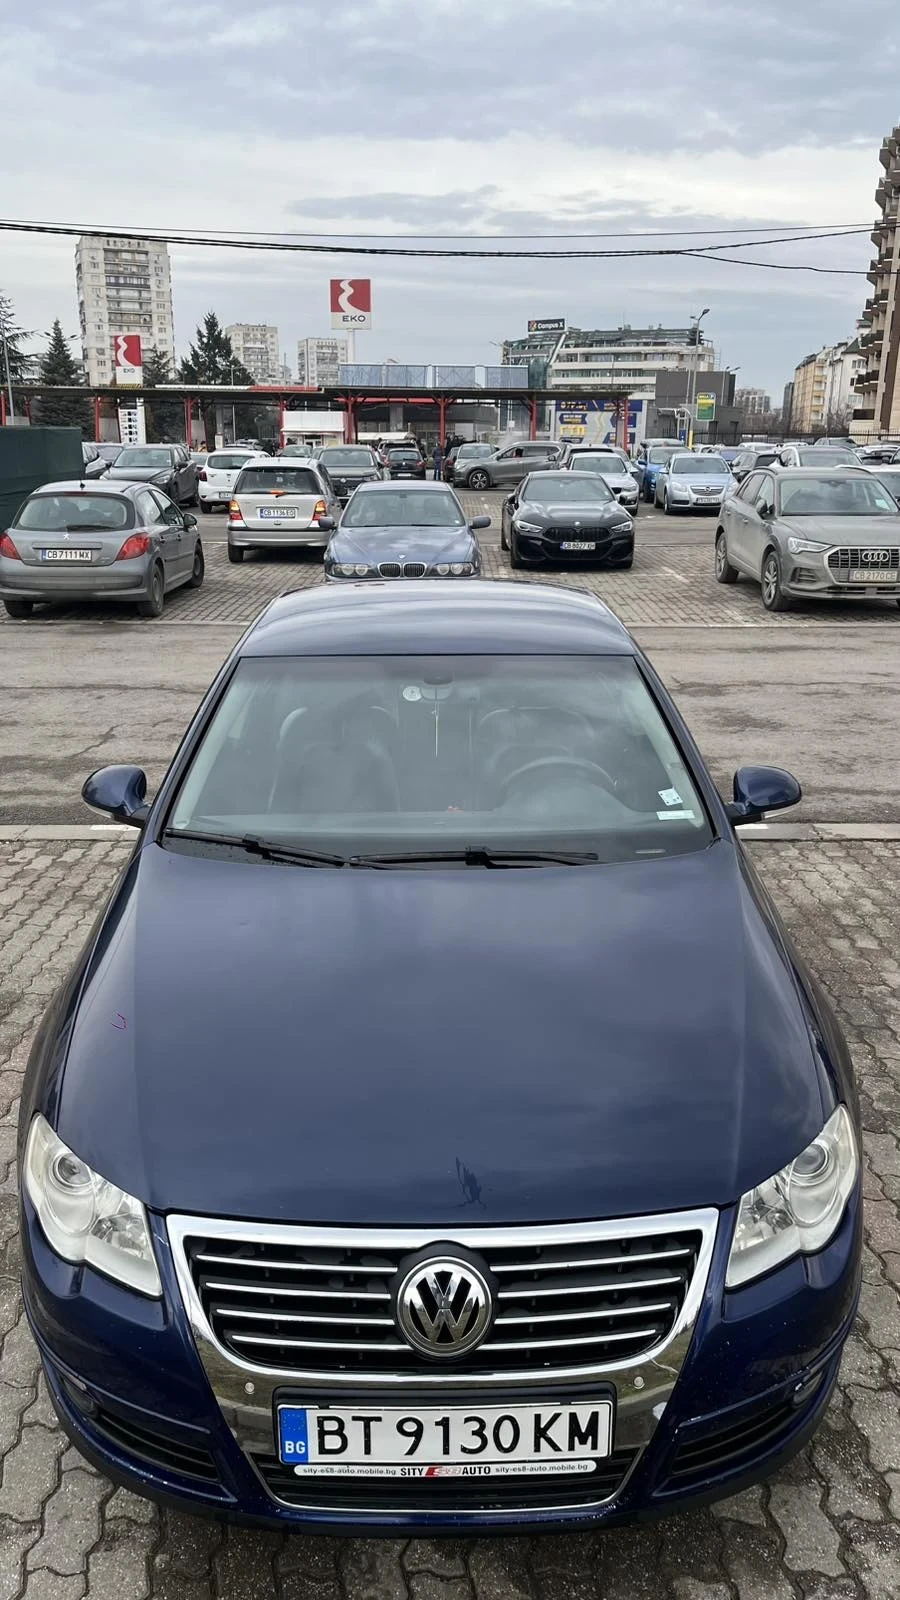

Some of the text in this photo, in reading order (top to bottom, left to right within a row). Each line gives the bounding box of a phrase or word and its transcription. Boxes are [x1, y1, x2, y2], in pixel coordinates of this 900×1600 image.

[342, 315, 366, 323] EKO
[316, 1411, 599, 1456] BT 9130 KM
[285, 1441, 306, 1454] BG
[400, 1466, 424, 1476] SITY
[462, 1466, 491, 1475] AUTO
